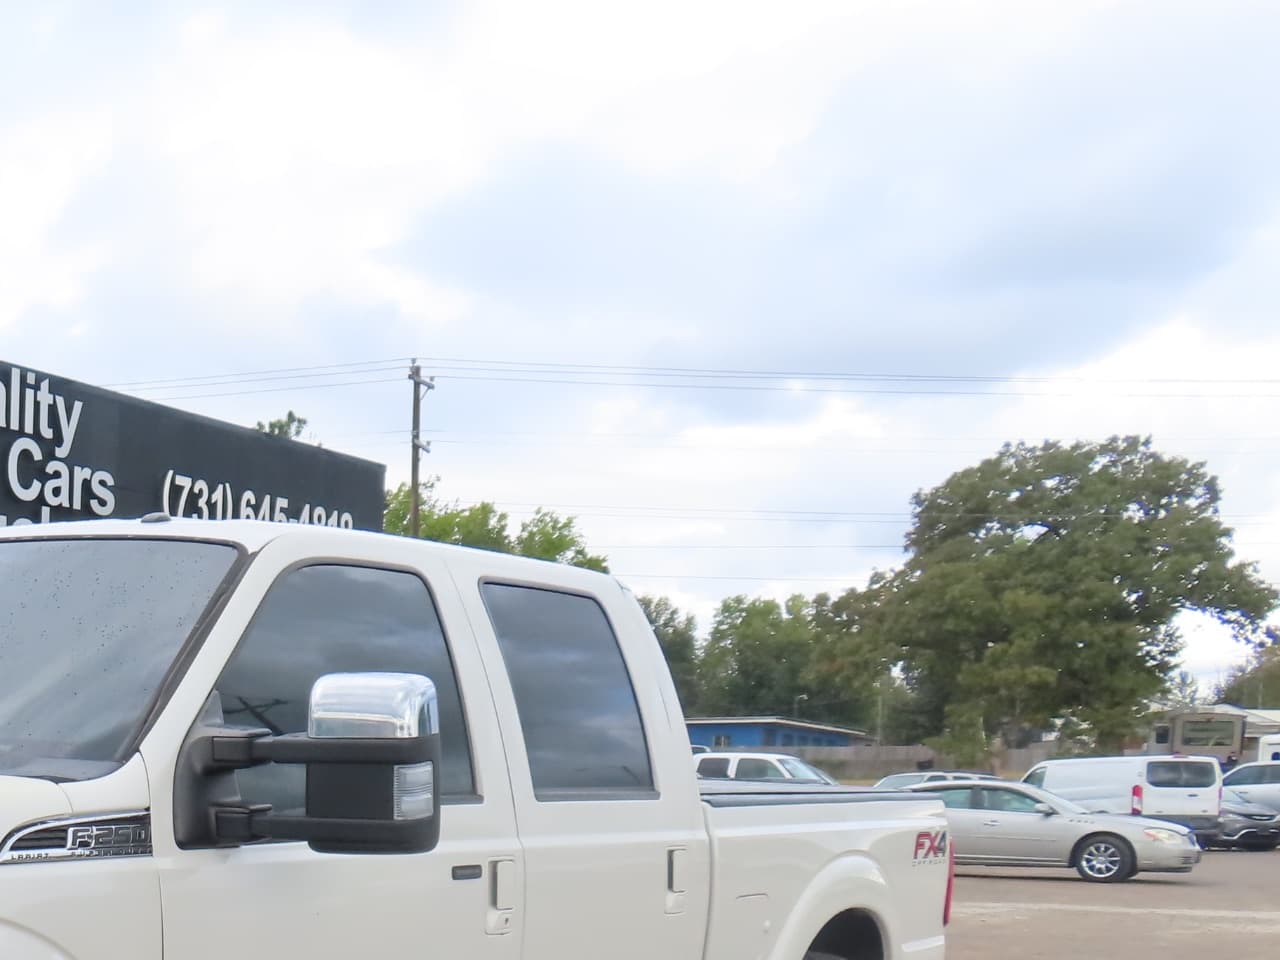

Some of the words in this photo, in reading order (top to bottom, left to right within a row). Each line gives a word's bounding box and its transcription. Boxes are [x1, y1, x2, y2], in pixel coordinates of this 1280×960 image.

[8, 437, 116, 516] Cars
[163, 470, 233, 520] (731)
[913, 829, 947, 859] FX4
